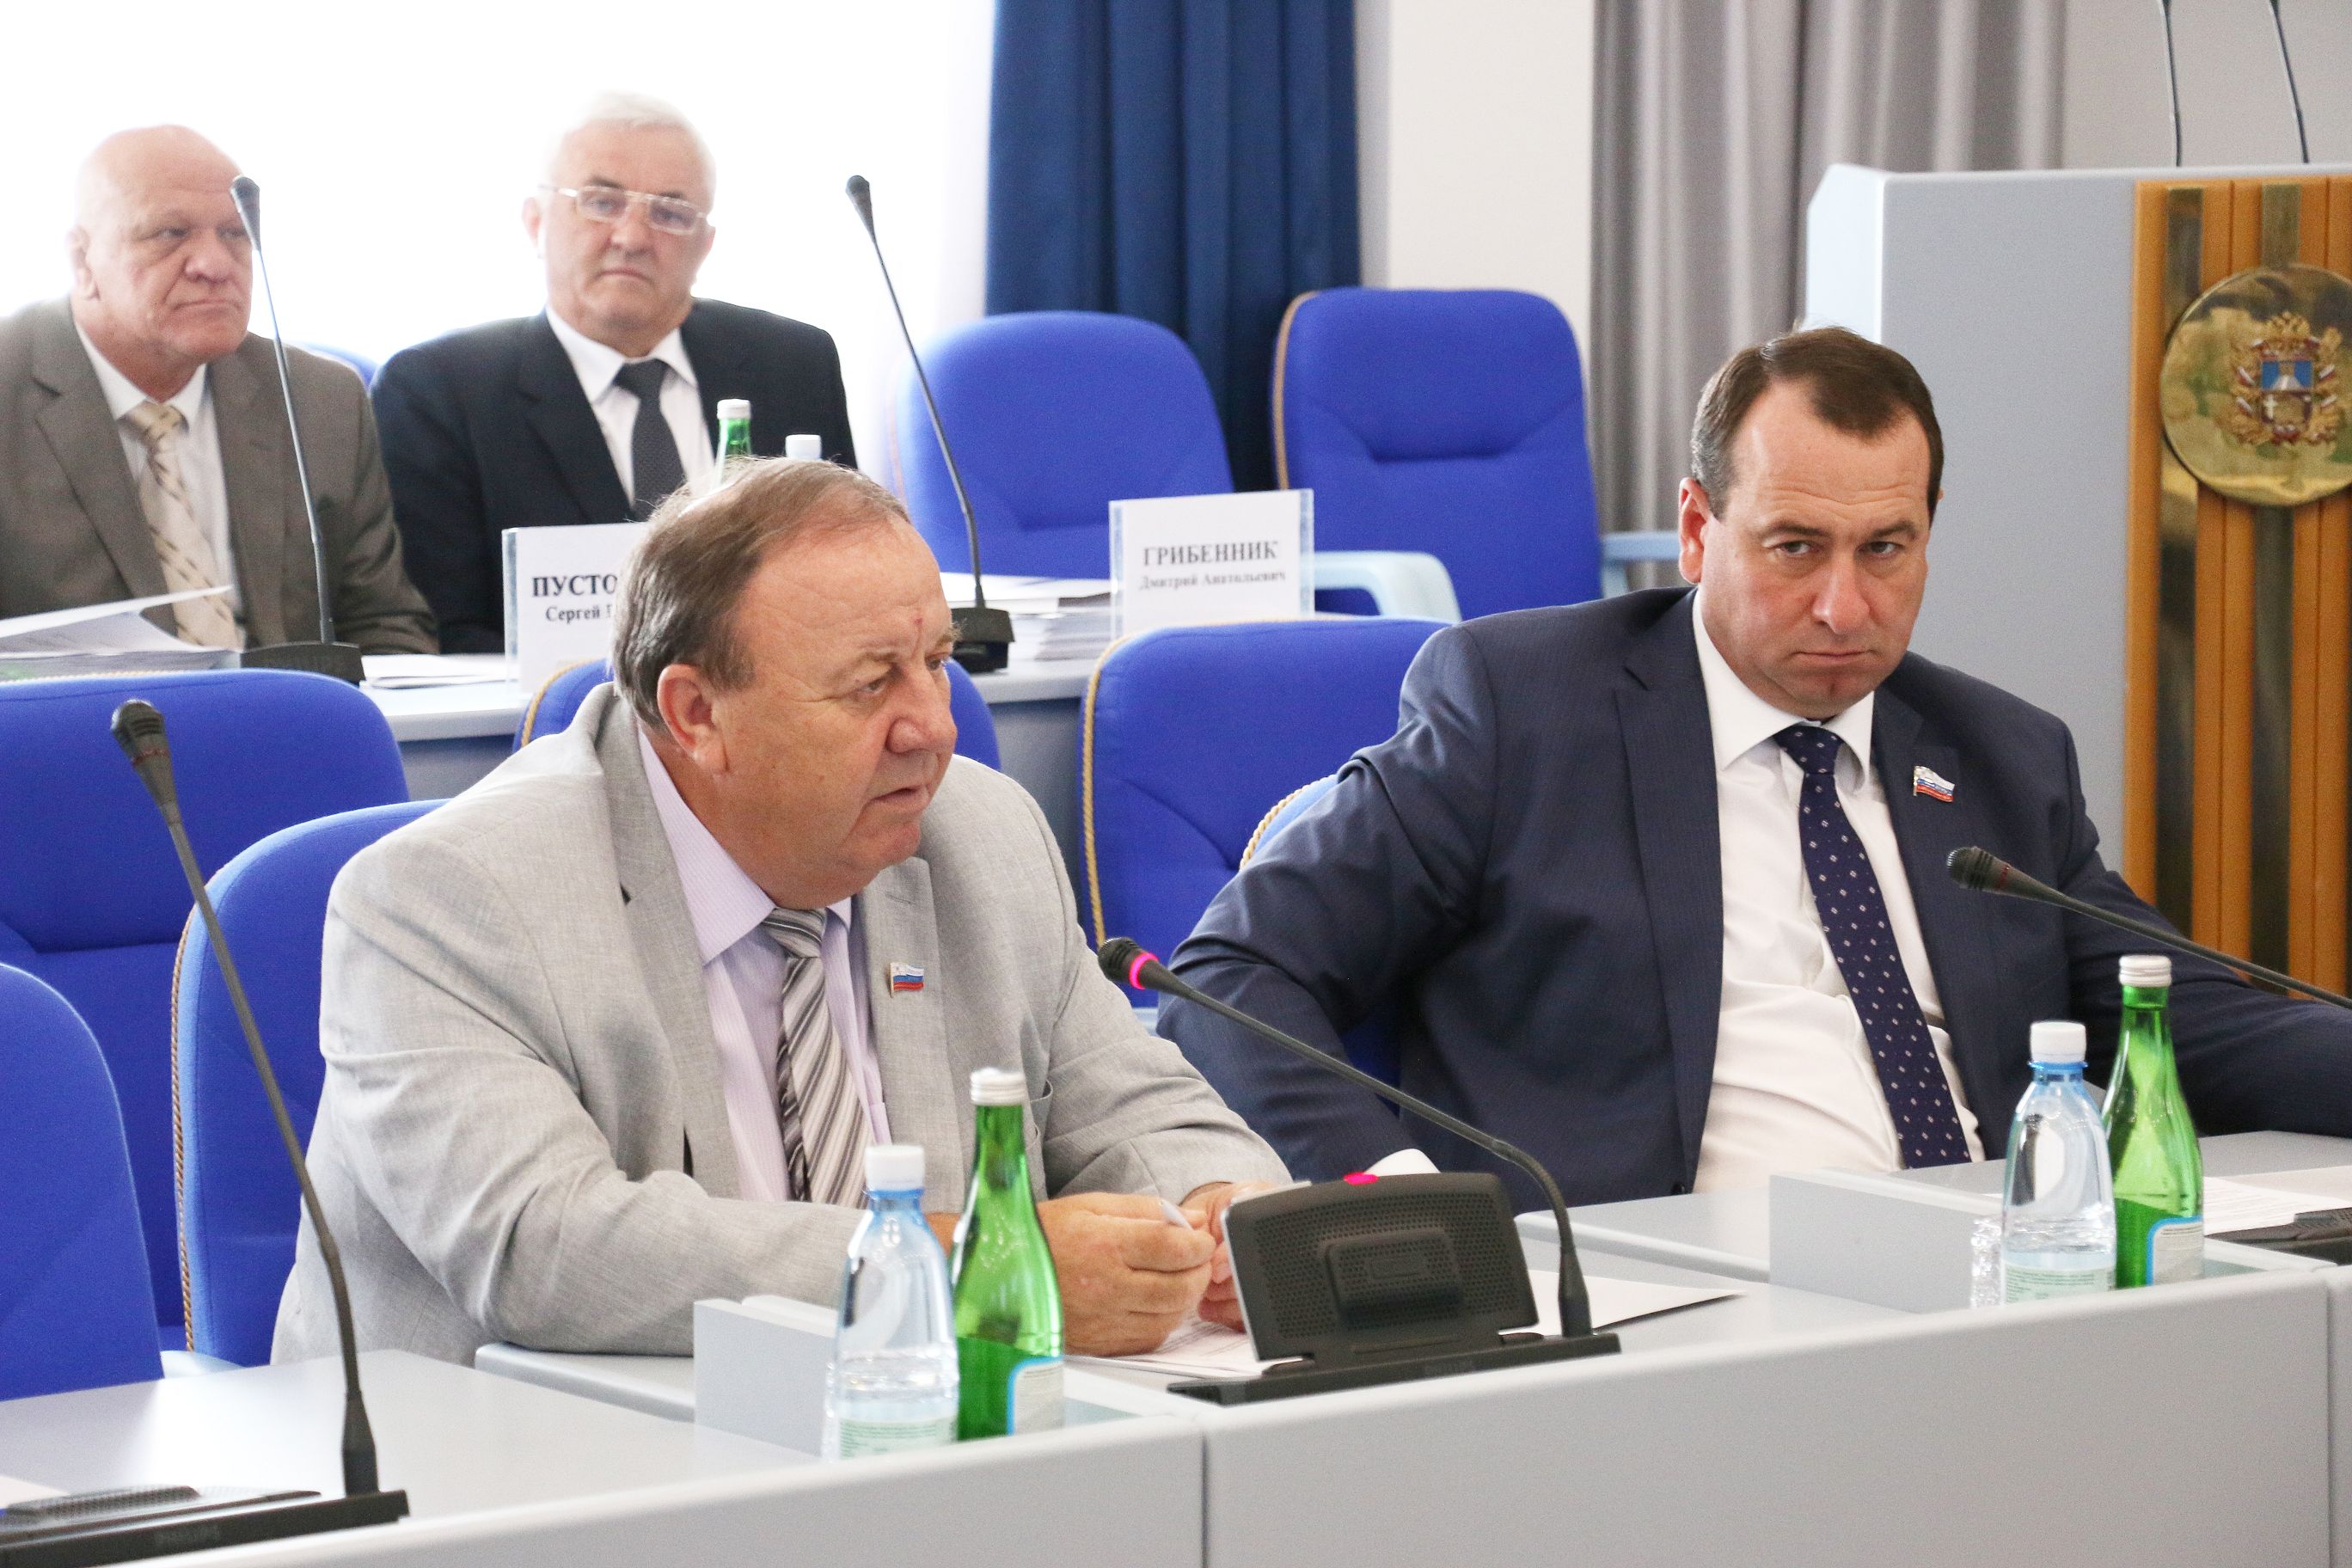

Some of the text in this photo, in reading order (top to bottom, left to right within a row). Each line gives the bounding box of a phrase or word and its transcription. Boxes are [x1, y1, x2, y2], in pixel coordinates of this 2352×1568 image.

[1143, 540, 1279, 567] ГРИБЕННИК
[532, 574, 618, 597] ПУСТО
[1140, 574, 1197, 591] Дмитрий
[546, 604, 601, 624] Сергей
